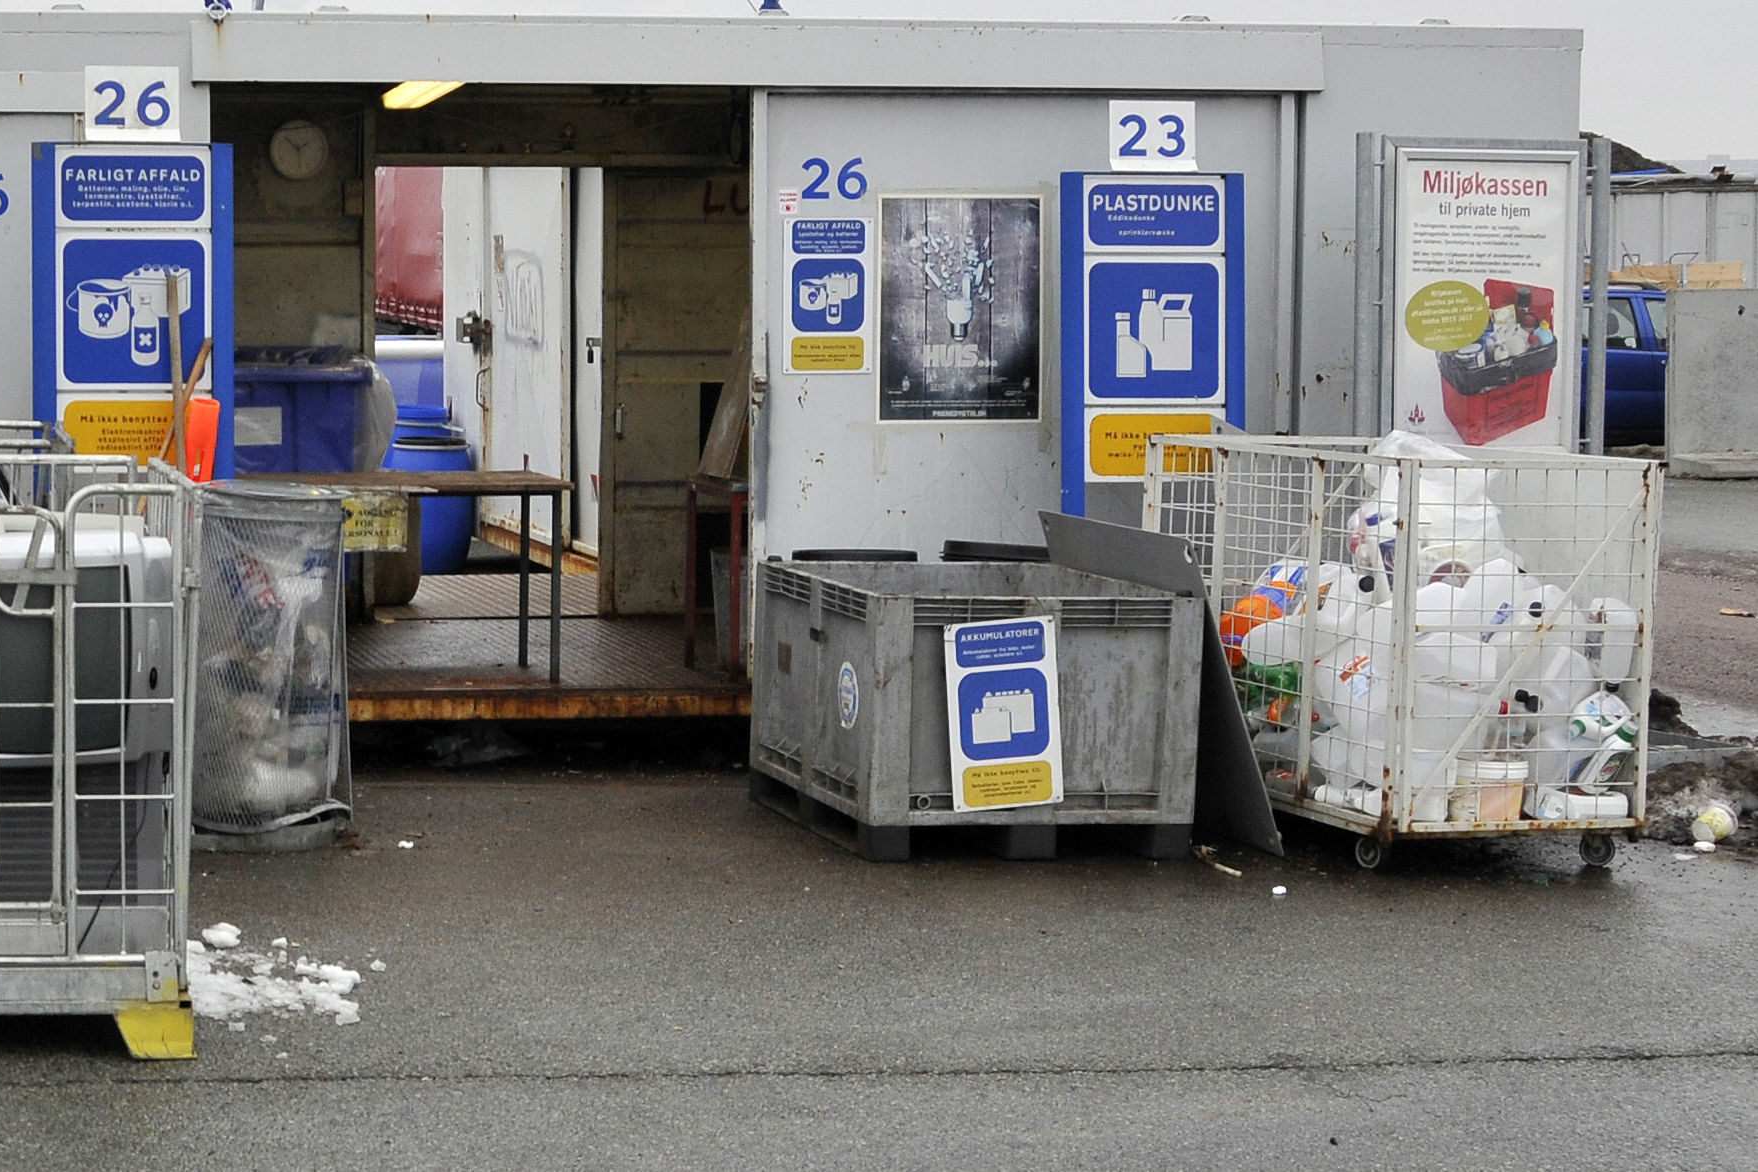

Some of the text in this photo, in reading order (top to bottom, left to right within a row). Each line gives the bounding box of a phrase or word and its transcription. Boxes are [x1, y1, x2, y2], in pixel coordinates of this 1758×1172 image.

[94, 81, 170, 127] 26
[1119, 114, 1186, 157] 23
[65, 168, 201, 182] FARLIGT AFFALD
[801, 157, 868, 200] 26
[1423, 170, 1548, 199] Miljøkassen
[1093, 194, 1215, 212] PLASTDUNKE
[1439, 202, 1531, 220] til private hjem
[797, 222, 861, 230] FARLIGT AFFALD
[122, 415, 168, 424] benyttes
[961, 628, 1040, 643] AKKUMULATORER
